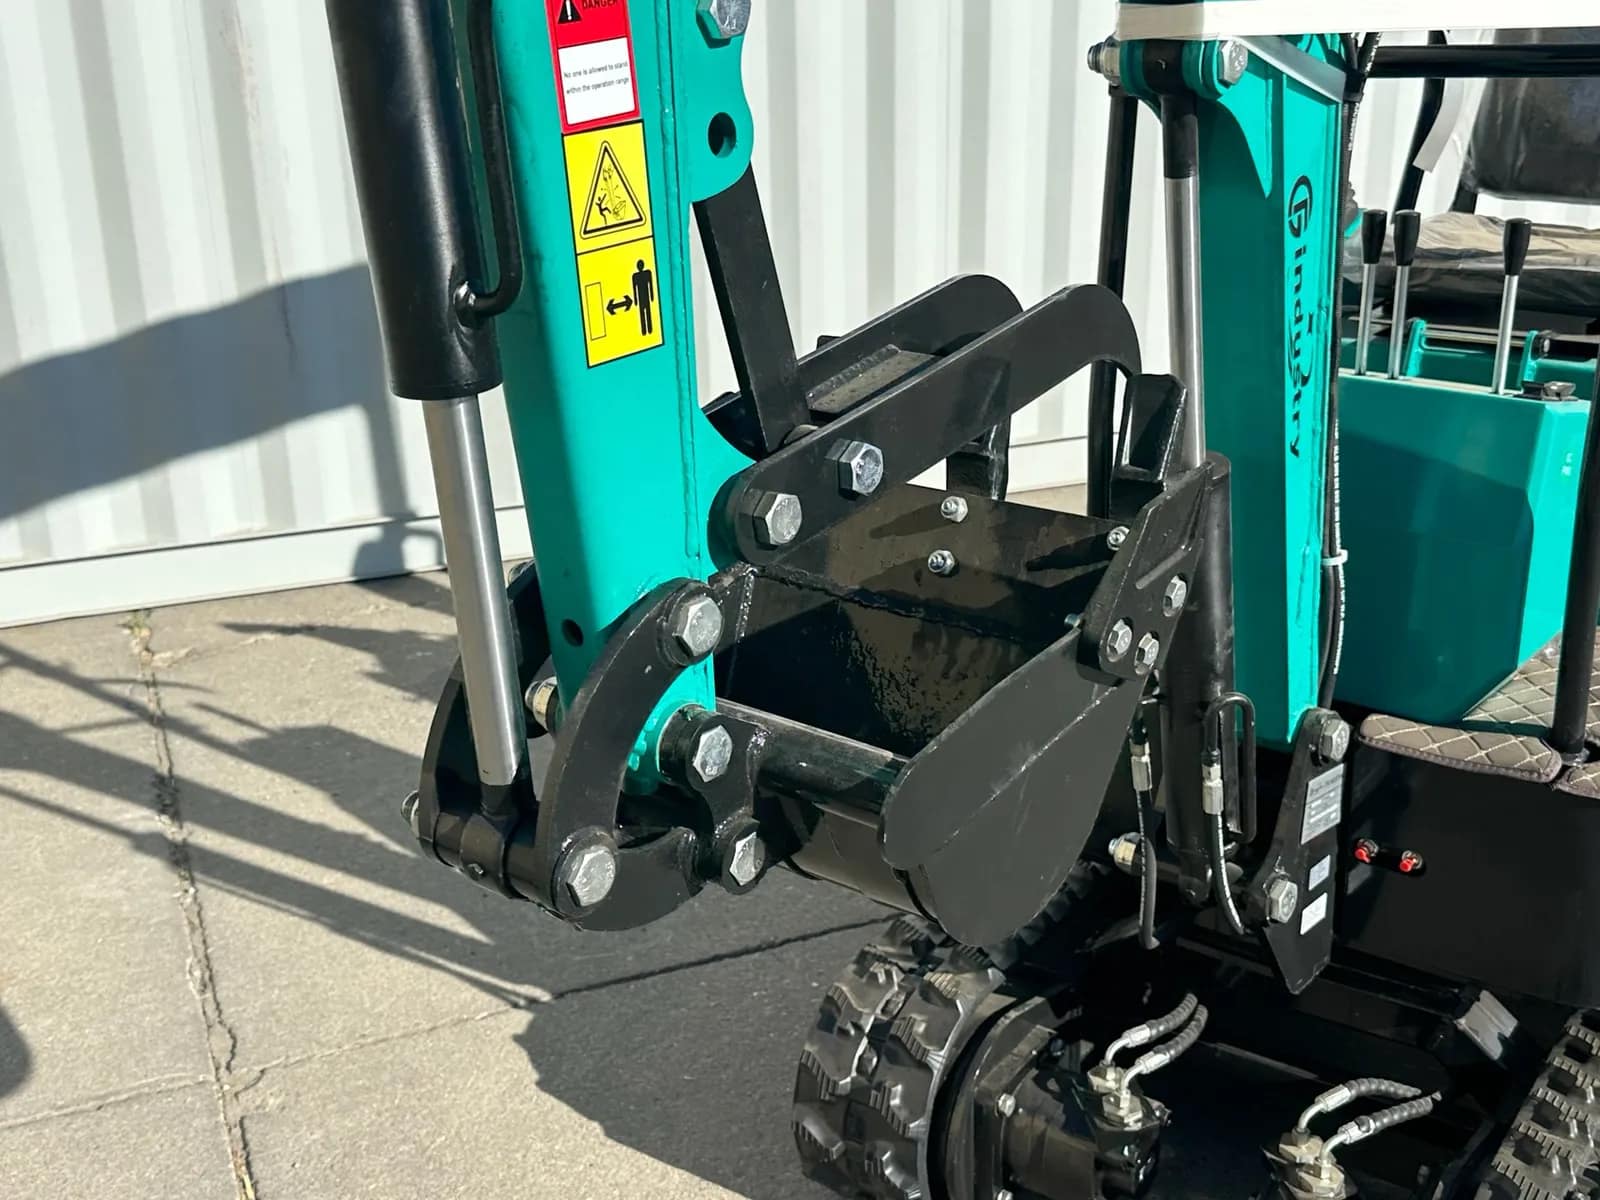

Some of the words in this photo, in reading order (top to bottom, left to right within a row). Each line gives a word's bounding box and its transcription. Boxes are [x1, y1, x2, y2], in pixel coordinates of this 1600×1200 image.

[588, 65, 608, 74] allowed
[615, 61, 628, 69] stand
[582, 84, 590, 92] the
[591, 80, 614, 90] operation
[615, 77, 629, 85] range
